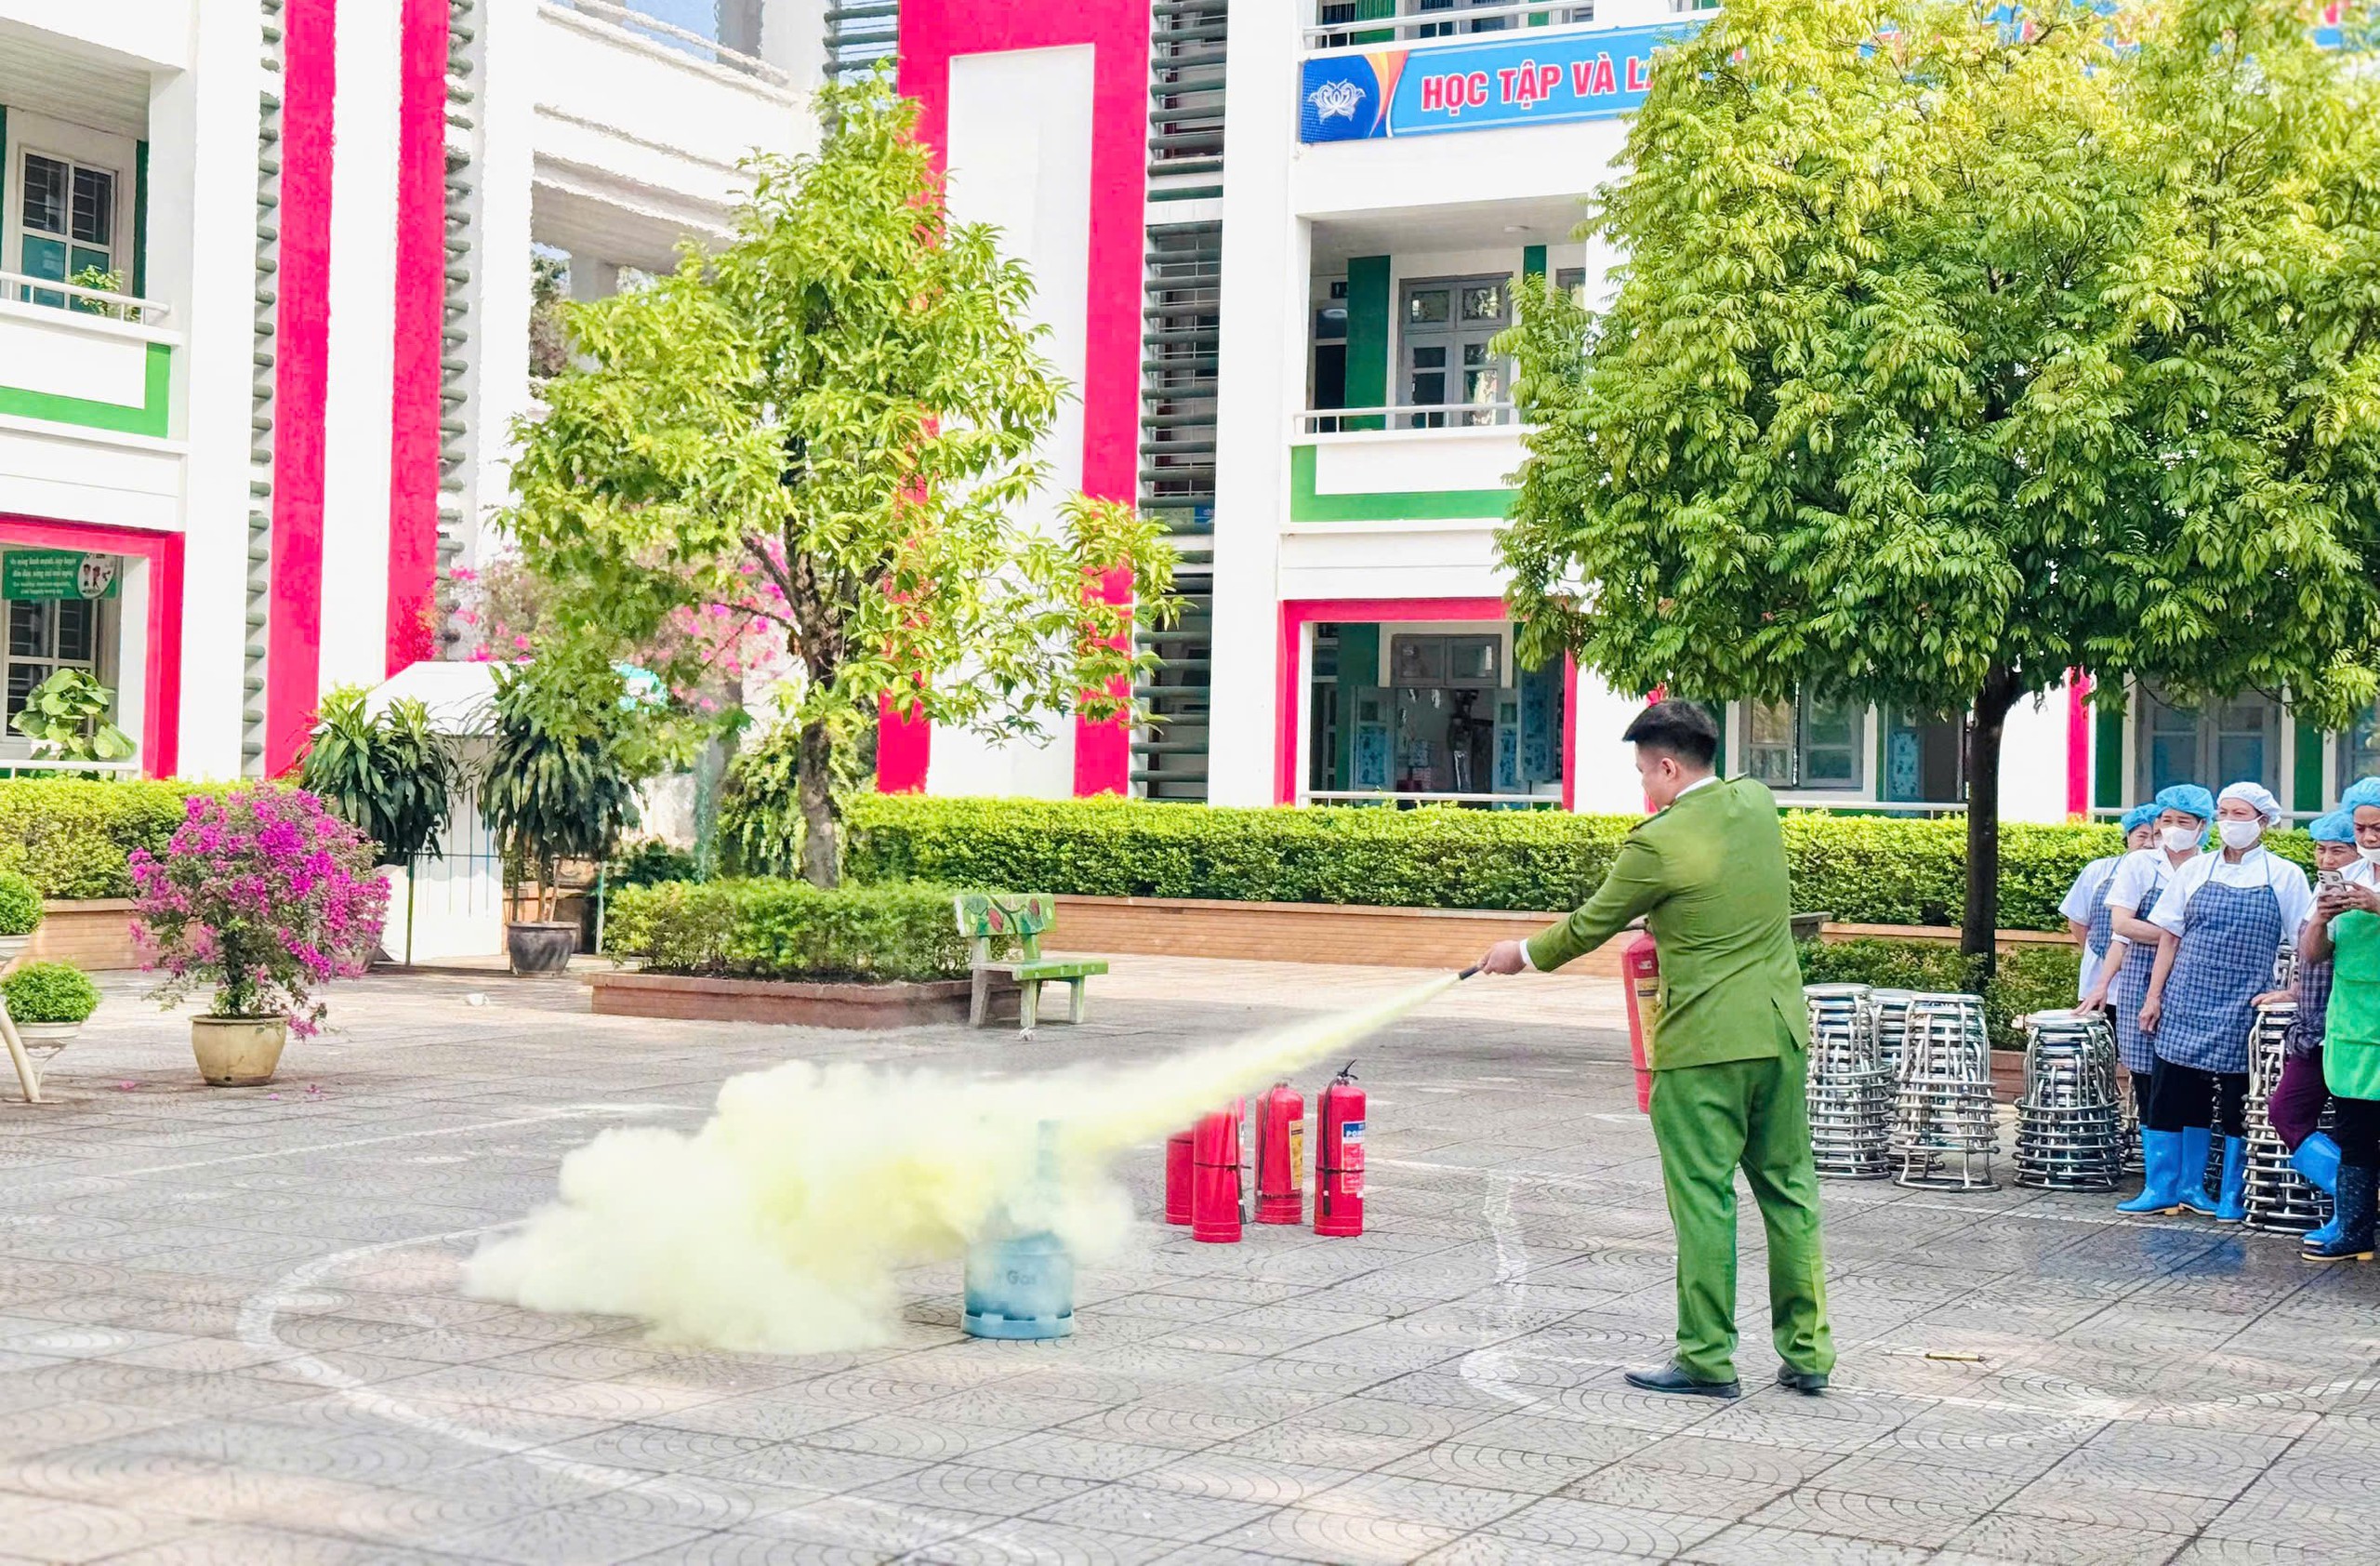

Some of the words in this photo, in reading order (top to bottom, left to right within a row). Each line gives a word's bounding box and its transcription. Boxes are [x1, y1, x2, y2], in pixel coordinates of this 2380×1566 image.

[1421, 72, 1488, 116] HỌC
[1497, 60, 1562, 110] TẬP
[1570, 52, 1616, 97] VÀ
[1007, 1270, 1037, 1285] Gas
